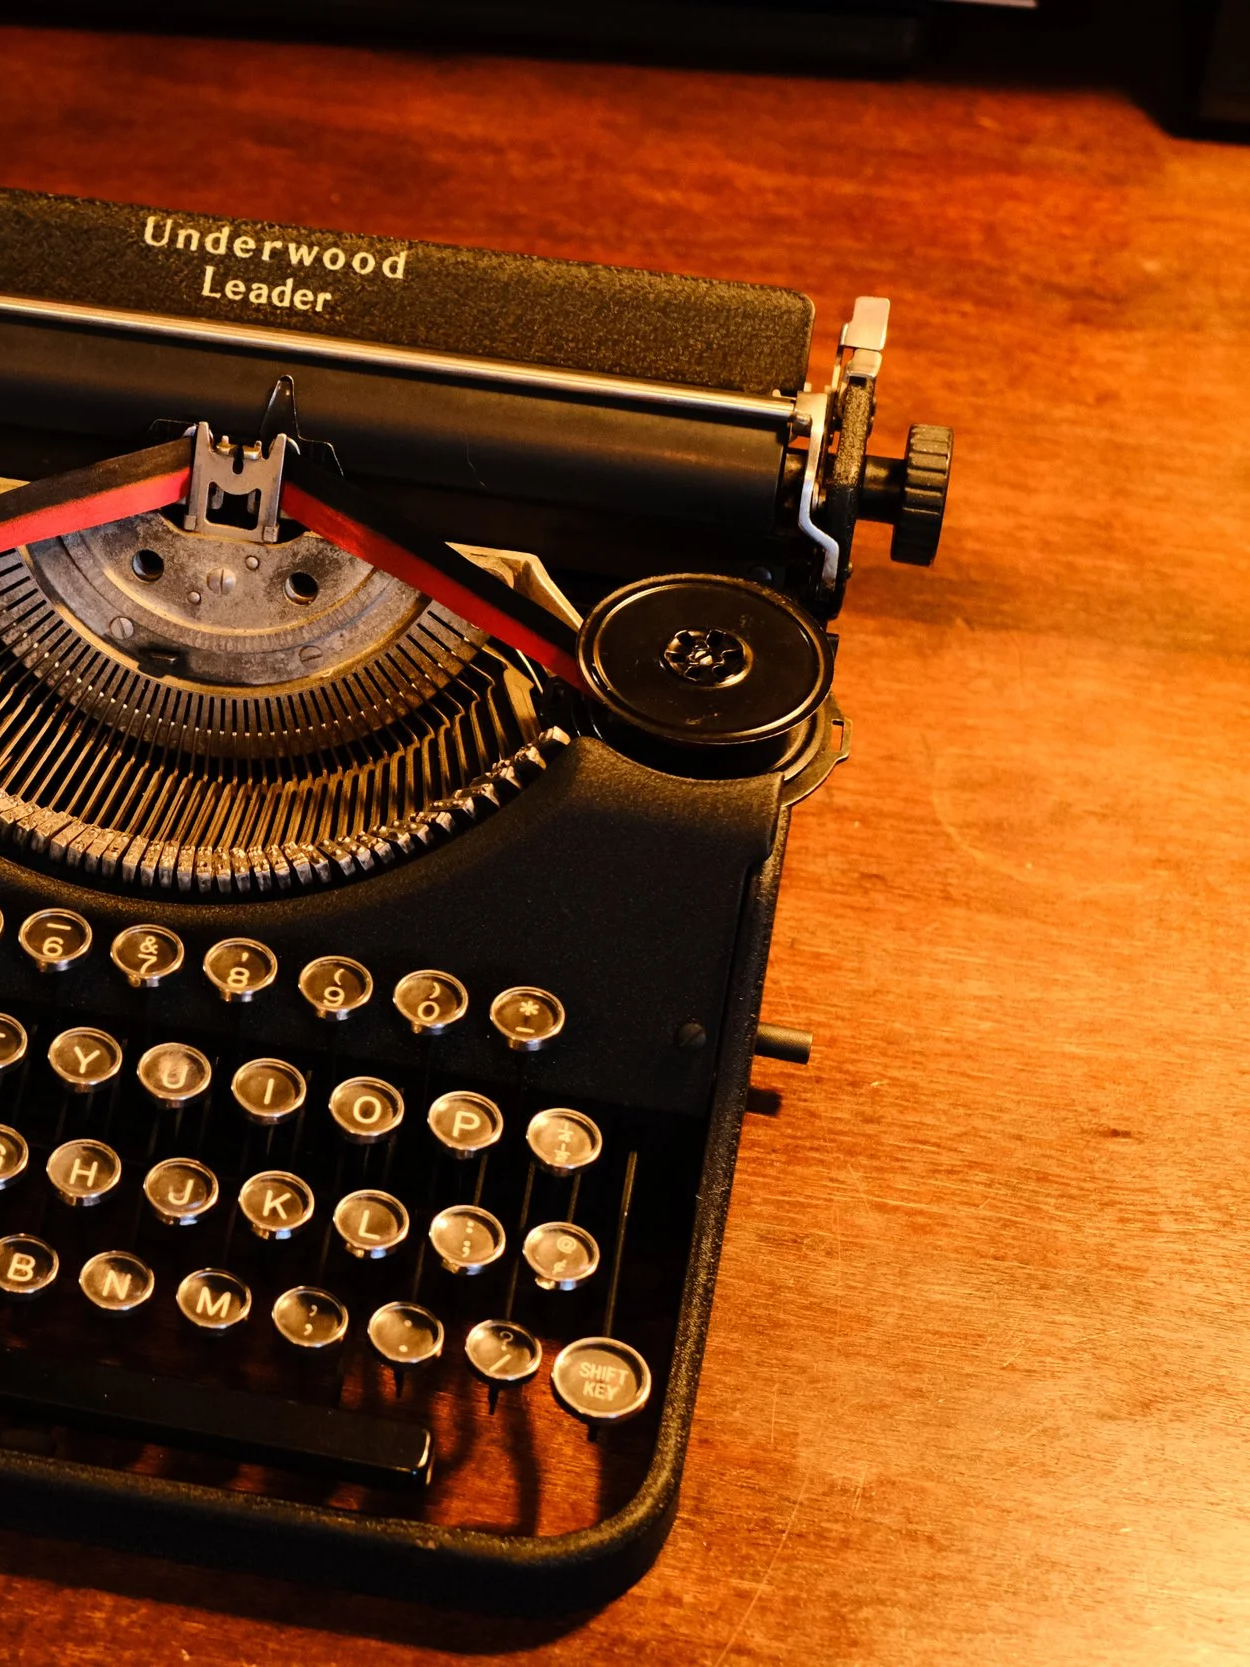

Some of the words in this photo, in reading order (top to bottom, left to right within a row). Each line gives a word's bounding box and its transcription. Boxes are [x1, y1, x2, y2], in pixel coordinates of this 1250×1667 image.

[144, 215, 407, 280] Underwood
[202, 265, 332, 313] Leader
[42, 936, 63, 956] 6
[140, 936, 159, 954] &
[137, 953, 158, 974] 7
[227, 967, 248, 988] 8
[324, 986, 344, 1007] 9
[72, 1046, 100, 1074] Y
[161, 1064, 188, 1090] U
[354, 1097, 381, 1124] O
[453, 1111, 482, 1137] P
[69, 1158, 98, 1187] H
[168, 1178, 193, 1205] J
[265, 1192, 291, 1220] K
[358, 1211, 381, 1239] L
[557, 1236, 576, 1255] @
[7, 1254, 33, 1282] B
[101, 1271, 132, 1299] N
[195, 1287, 232, 1317] M
[488, 1353, 511, 1372] /
[579, 1360, 629, 1381] SHIFT
[582, 1381, 618, 1400] KEY
